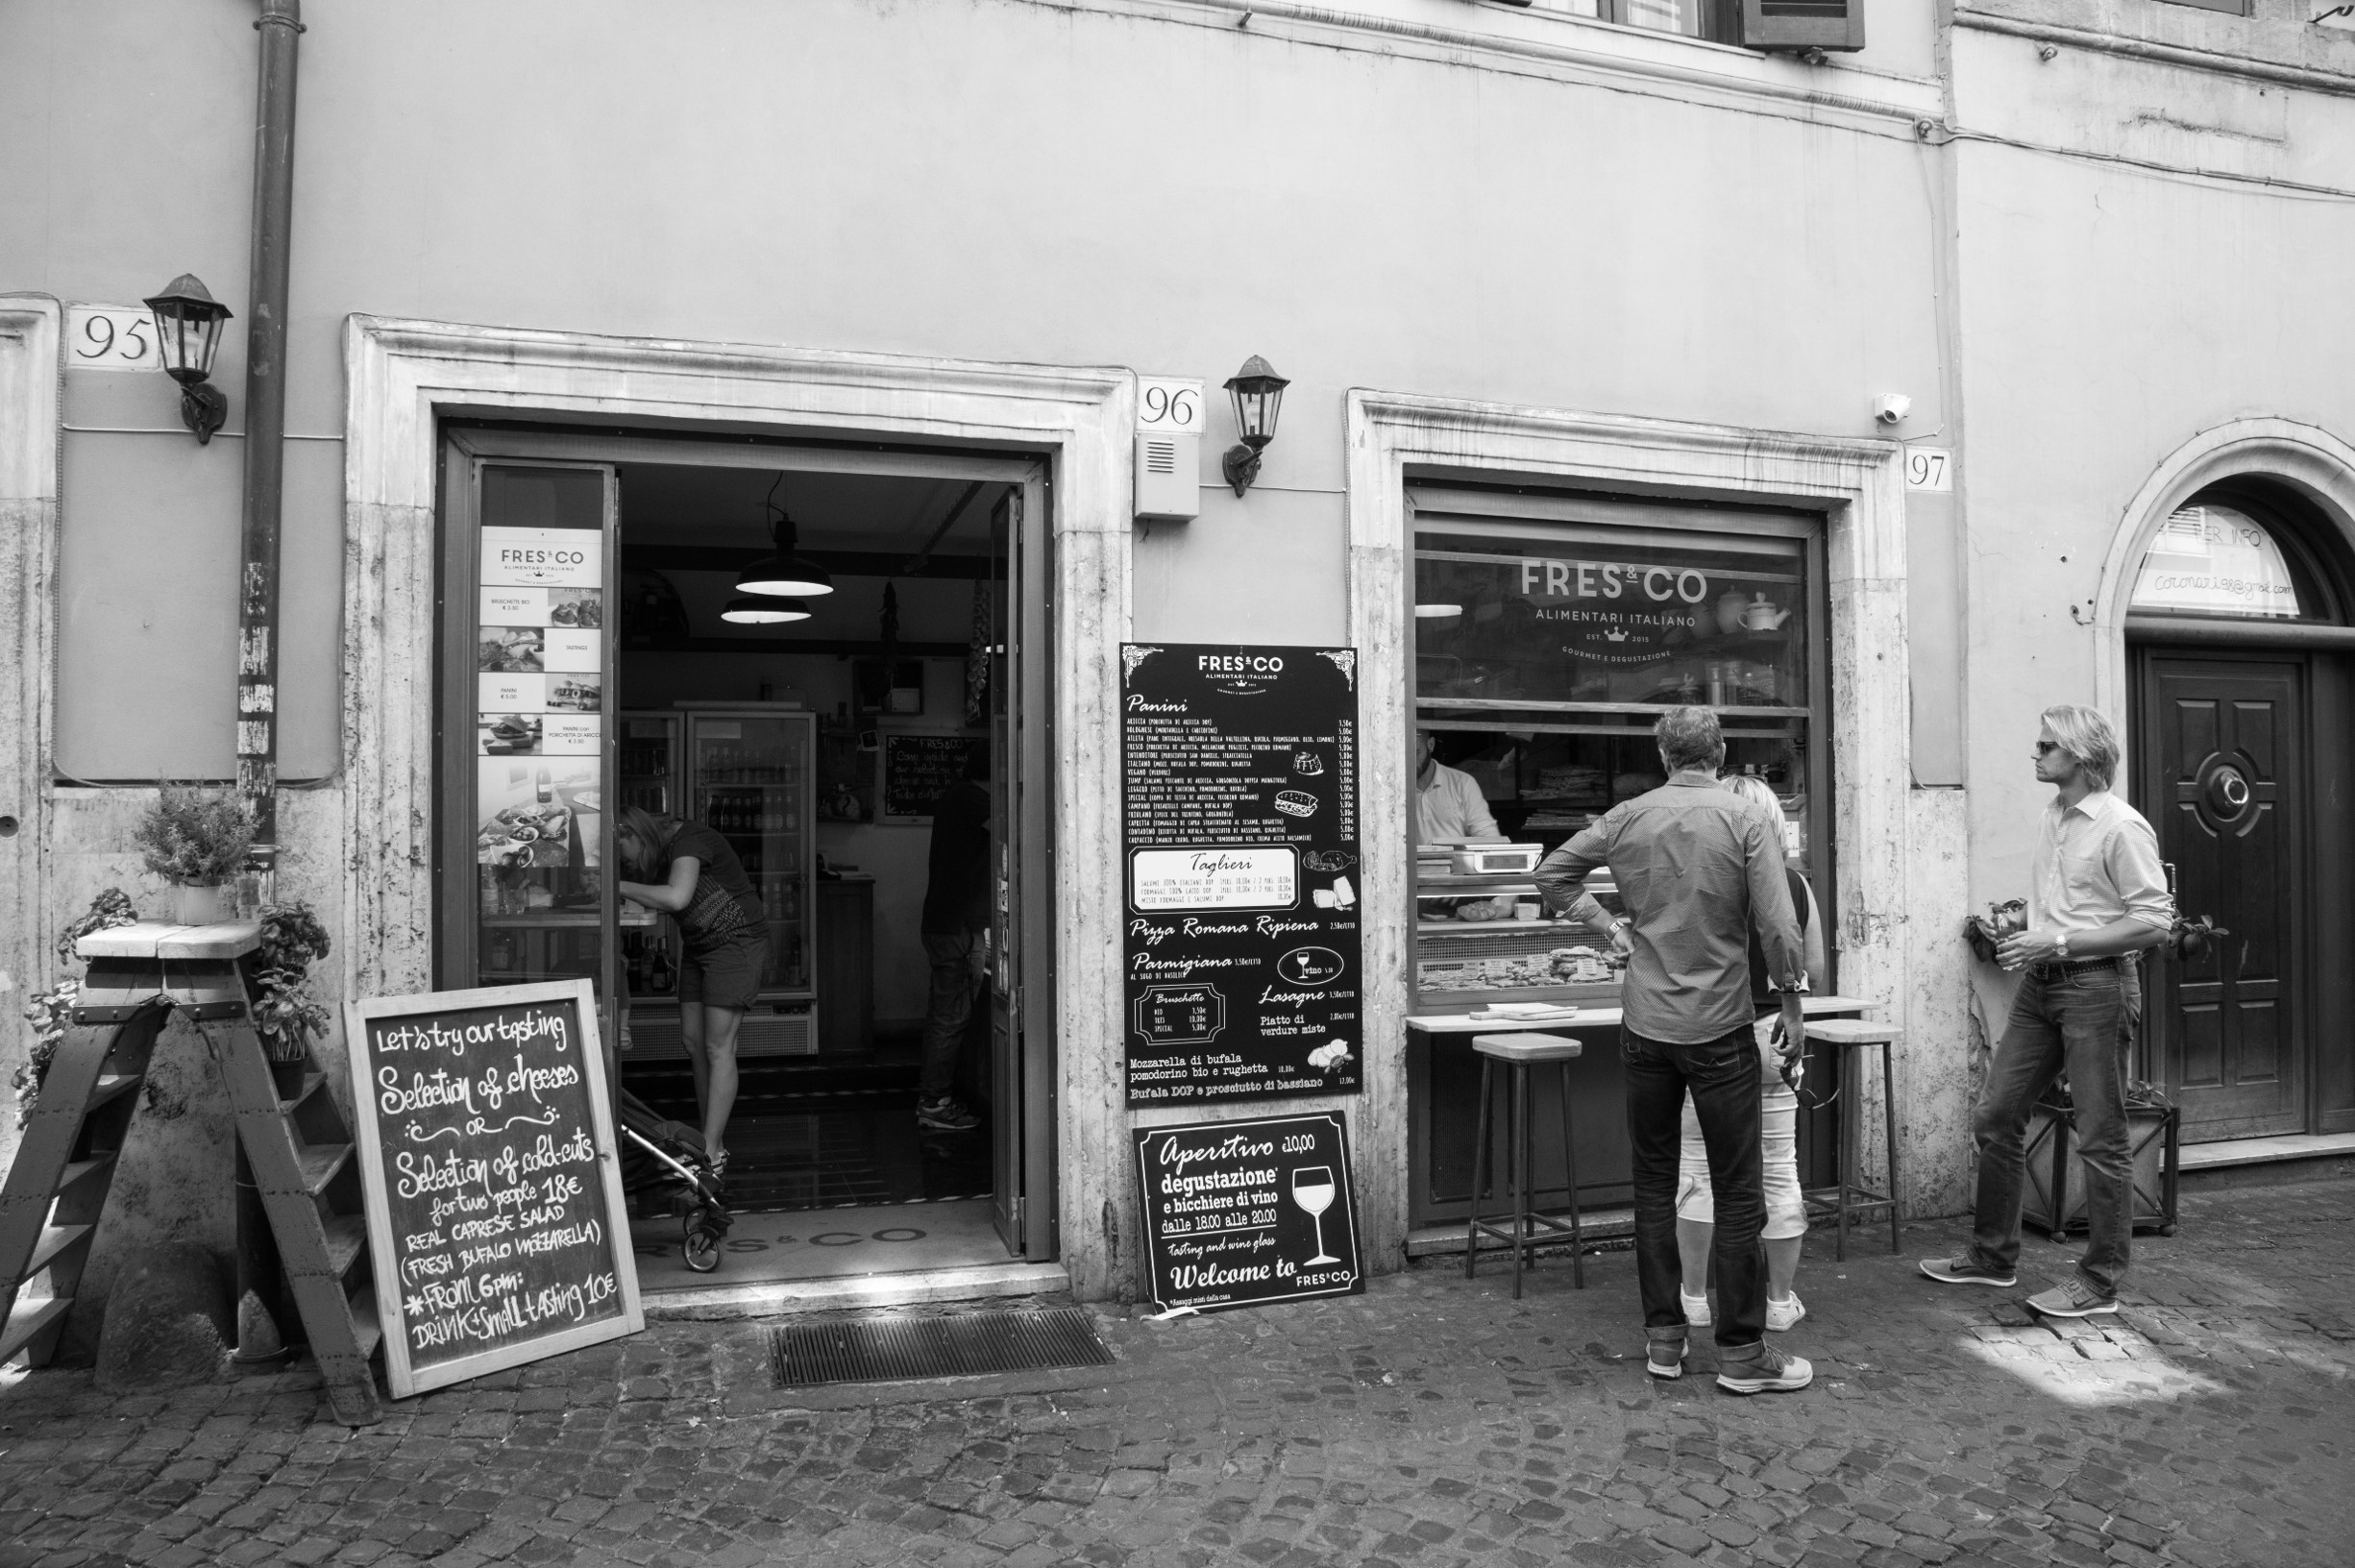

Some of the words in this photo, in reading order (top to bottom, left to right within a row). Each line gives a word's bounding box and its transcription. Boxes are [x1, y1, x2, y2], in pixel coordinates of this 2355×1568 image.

[76, 315, 152, 360] 95
[1141, 386, 1198, 425] 96
[1908, 454, 1945, 486] 97
[2231, 528, 2261, 547] INFO
[1521, 559, 1707, 603] FRES&CO
[1535, 608, 1624, 624] ALIMENTARI
[1630, 613, 1696, 627] ITALIANO
[1562, 646, 1602, 661] GOURMET
[1611, 649, 1672, 663] DEGUSTAZIONE
[1126, 694, 1189, 712] Panini
[1190, 852, 1253, 877] Taglieri
[1129, 919, 1176, 945] Pizza
[1183, 918, 1249, 939] Romana
[1256, 915, 1319, 940] Ripiena
[1133, 952, 1233, 976] Parmigiana
[1259, 985, 1325, 1009] Lasagne
[377, 1025, 431, 1053] Let's
[432, 1021, 465, 1056] try
[466, 1022, 496, 1043] our
[497, 1009, 567, 1052] tasting
[1260, 1016, 1291, 1026] Piatto
[1293, 1014, 1305, 1024] di
[1261, 1025, 1298, 1037] verdure
[1301, 1023, 1326, 1035] miste
[1130, 1056, 1187, 1069] Mozzarella
[1190, 1055, 1202, 1066] di
[1207, 1053, 1242, 1065] bufala
[1130, 1069, 1188, 1083] pomodorino
[1192, 1066, 1209, 1077] bio
[1222, 1064, 1269, 1077] rughetta
[379, 1066, 481, 1115] Selection
[478, 1066, 503, 1110] of
[505, 1054, 578, 1104] cheeses
[1130, 1087, 1169, 1100] Bufala
[1171, 1086, 1194, 1097] DOP
[1205, 1081, 1263, 1096] prosciutto
[1264, 1080, 1276, 1090] di
[1277, 1077, 1323, 1090] bassiano
[466, 1116, 492, 1136] OR
[1159, 1134, 1274, 1176] Aperitivo
[396, 1148, 492, 1199] Selection
[493, 1145, 519, 1186] of
[429, 1197, 456, 1227] for
[454, 1188, 489, 1213] two
[493, 1180, 538, 1214] people
[541, 1173, 583, 1204] 18€
[1164, 1202, 1171, 1214] e
[1173, 1195, 1234, 1214] bicchiere
[1236, 1192, 1250, 1207] di
[1251, 1189, 1279, 1206] vino
[405, 1229, 448, 1253] REAL
[452, 1214, 516, 1240] CAPRESE
[520, 1205, 565, 1229] SALAD
[1162, 1217, 1192, 1235] dalle
[1195, 1213, 1222, 1231] 18.00
[1225, 1211, 1248, 1228] alle
[1251, 1209, 1277, 1225] 20.00
[401, 1253, 454, 1287] (FRESH
[458, 1242, 512, 1273] BUFALO
[515, 1218, 601, 1257] MOZZARELLA)
[1167, 1241, 1204, 1261] tasting
[1206, 1237, 1227, 1254] and
[1228, 1237, 1252, 1252] wine
[1253, 1232, 1277, 1254] glass
[1169, 1262, 1271, 1290] Welcome
[1276, 1256, 1297, 1278] to
[583, 1272, 618, 1305] 10€
